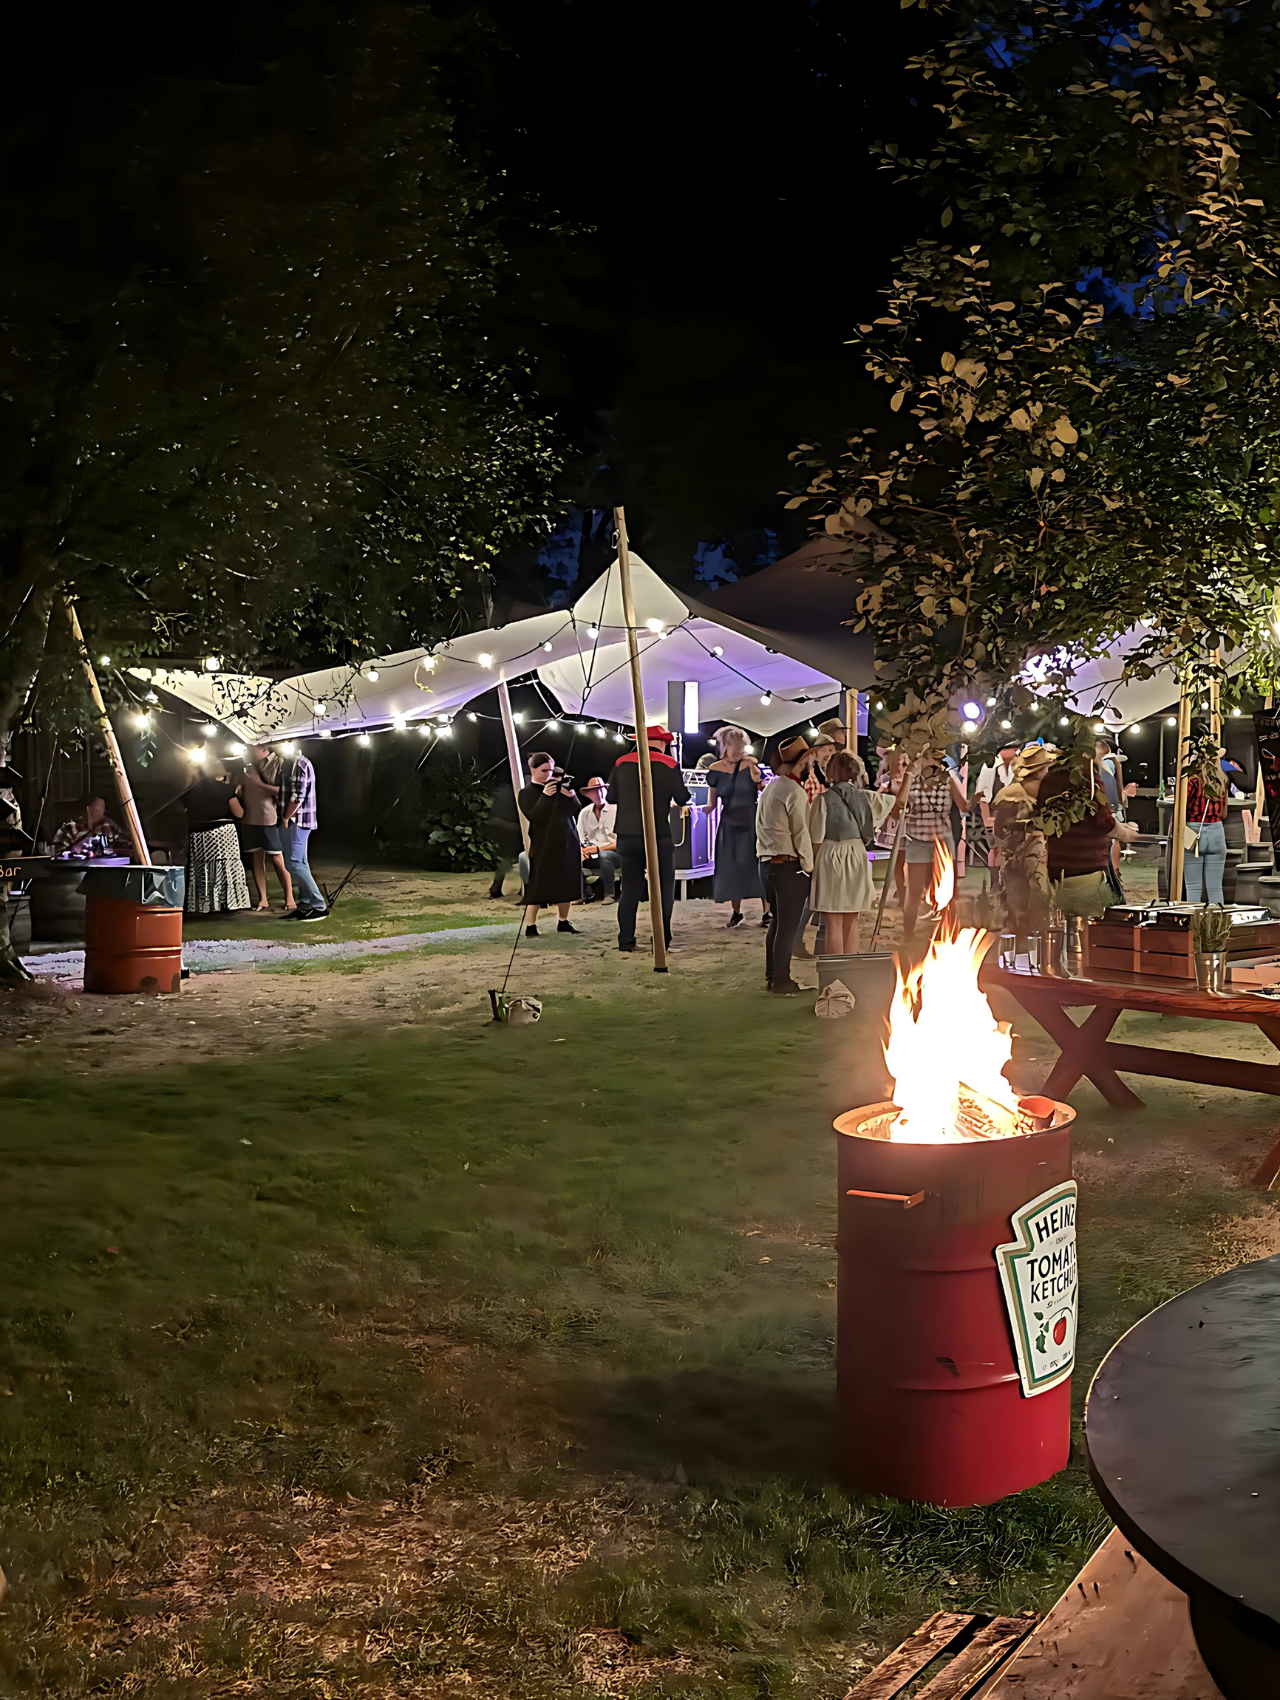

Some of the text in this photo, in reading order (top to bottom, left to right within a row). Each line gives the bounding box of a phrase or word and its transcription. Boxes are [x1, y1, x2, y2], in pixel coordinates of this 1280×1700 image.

[0, 864, 21, 878] Bar
[1034, 1203, 1075, 1244] HEINZ
[1027, 1241, 1076, 1283] TOMAT
